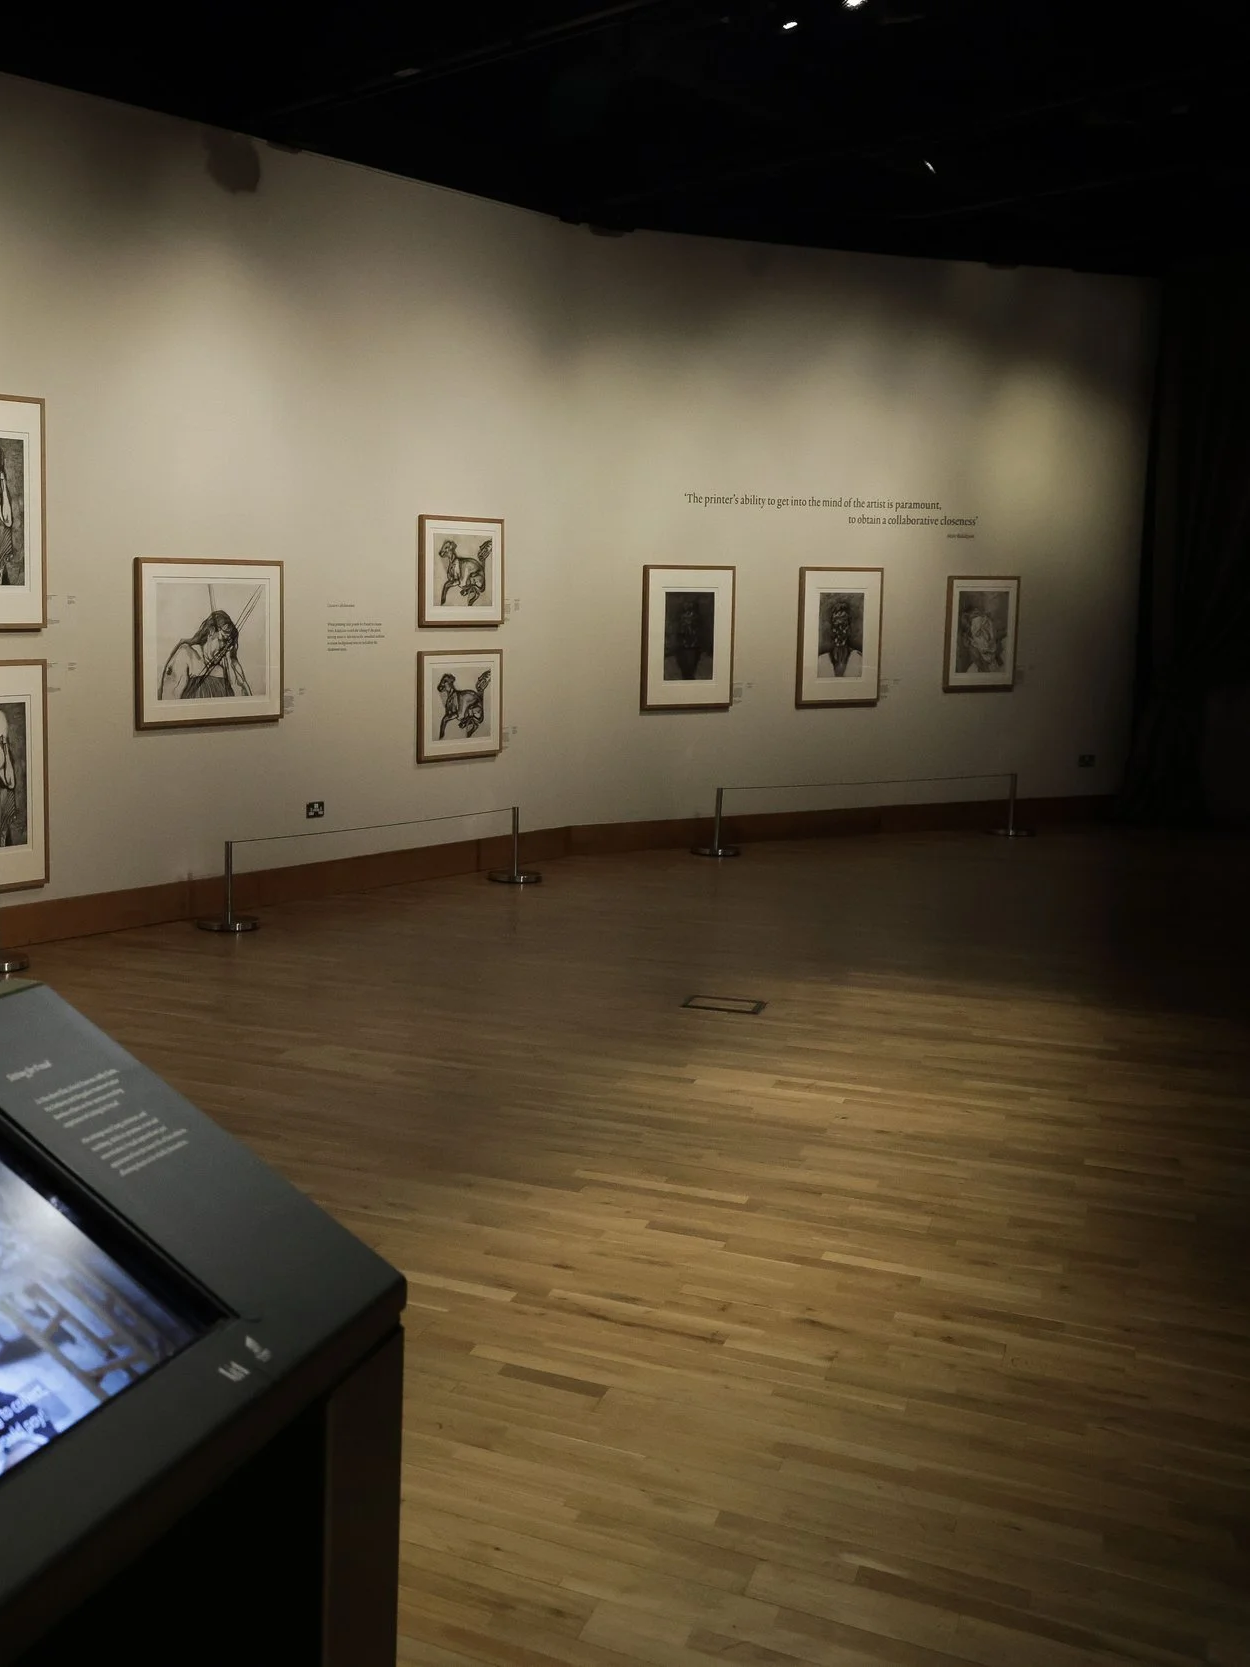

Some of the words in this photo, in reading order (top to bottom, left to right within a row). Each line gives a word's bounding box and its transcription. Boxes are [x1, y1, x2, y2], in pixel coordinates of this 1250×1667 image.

[740, 494, 765, 508] ability
[767, 495, 775, 505] to
[776, 496, 788, 509] get
[790, 495, 806, 506] into
[807, 496, 820, 506] the
[822, 497, 842, 507] mind
[843, 497, 852, 507] of
[853, 497, 865, 508] the
[866, 498, 885, 508] artist
[887, 498, 893, 508] is
[894, 501, 942, 512] paramount,
[848, 515, 856, 524] to
[857, 513, 880, 524] obtain
[882, 516, 886, 524] a
[887, 514, 938, 525] collaborative
